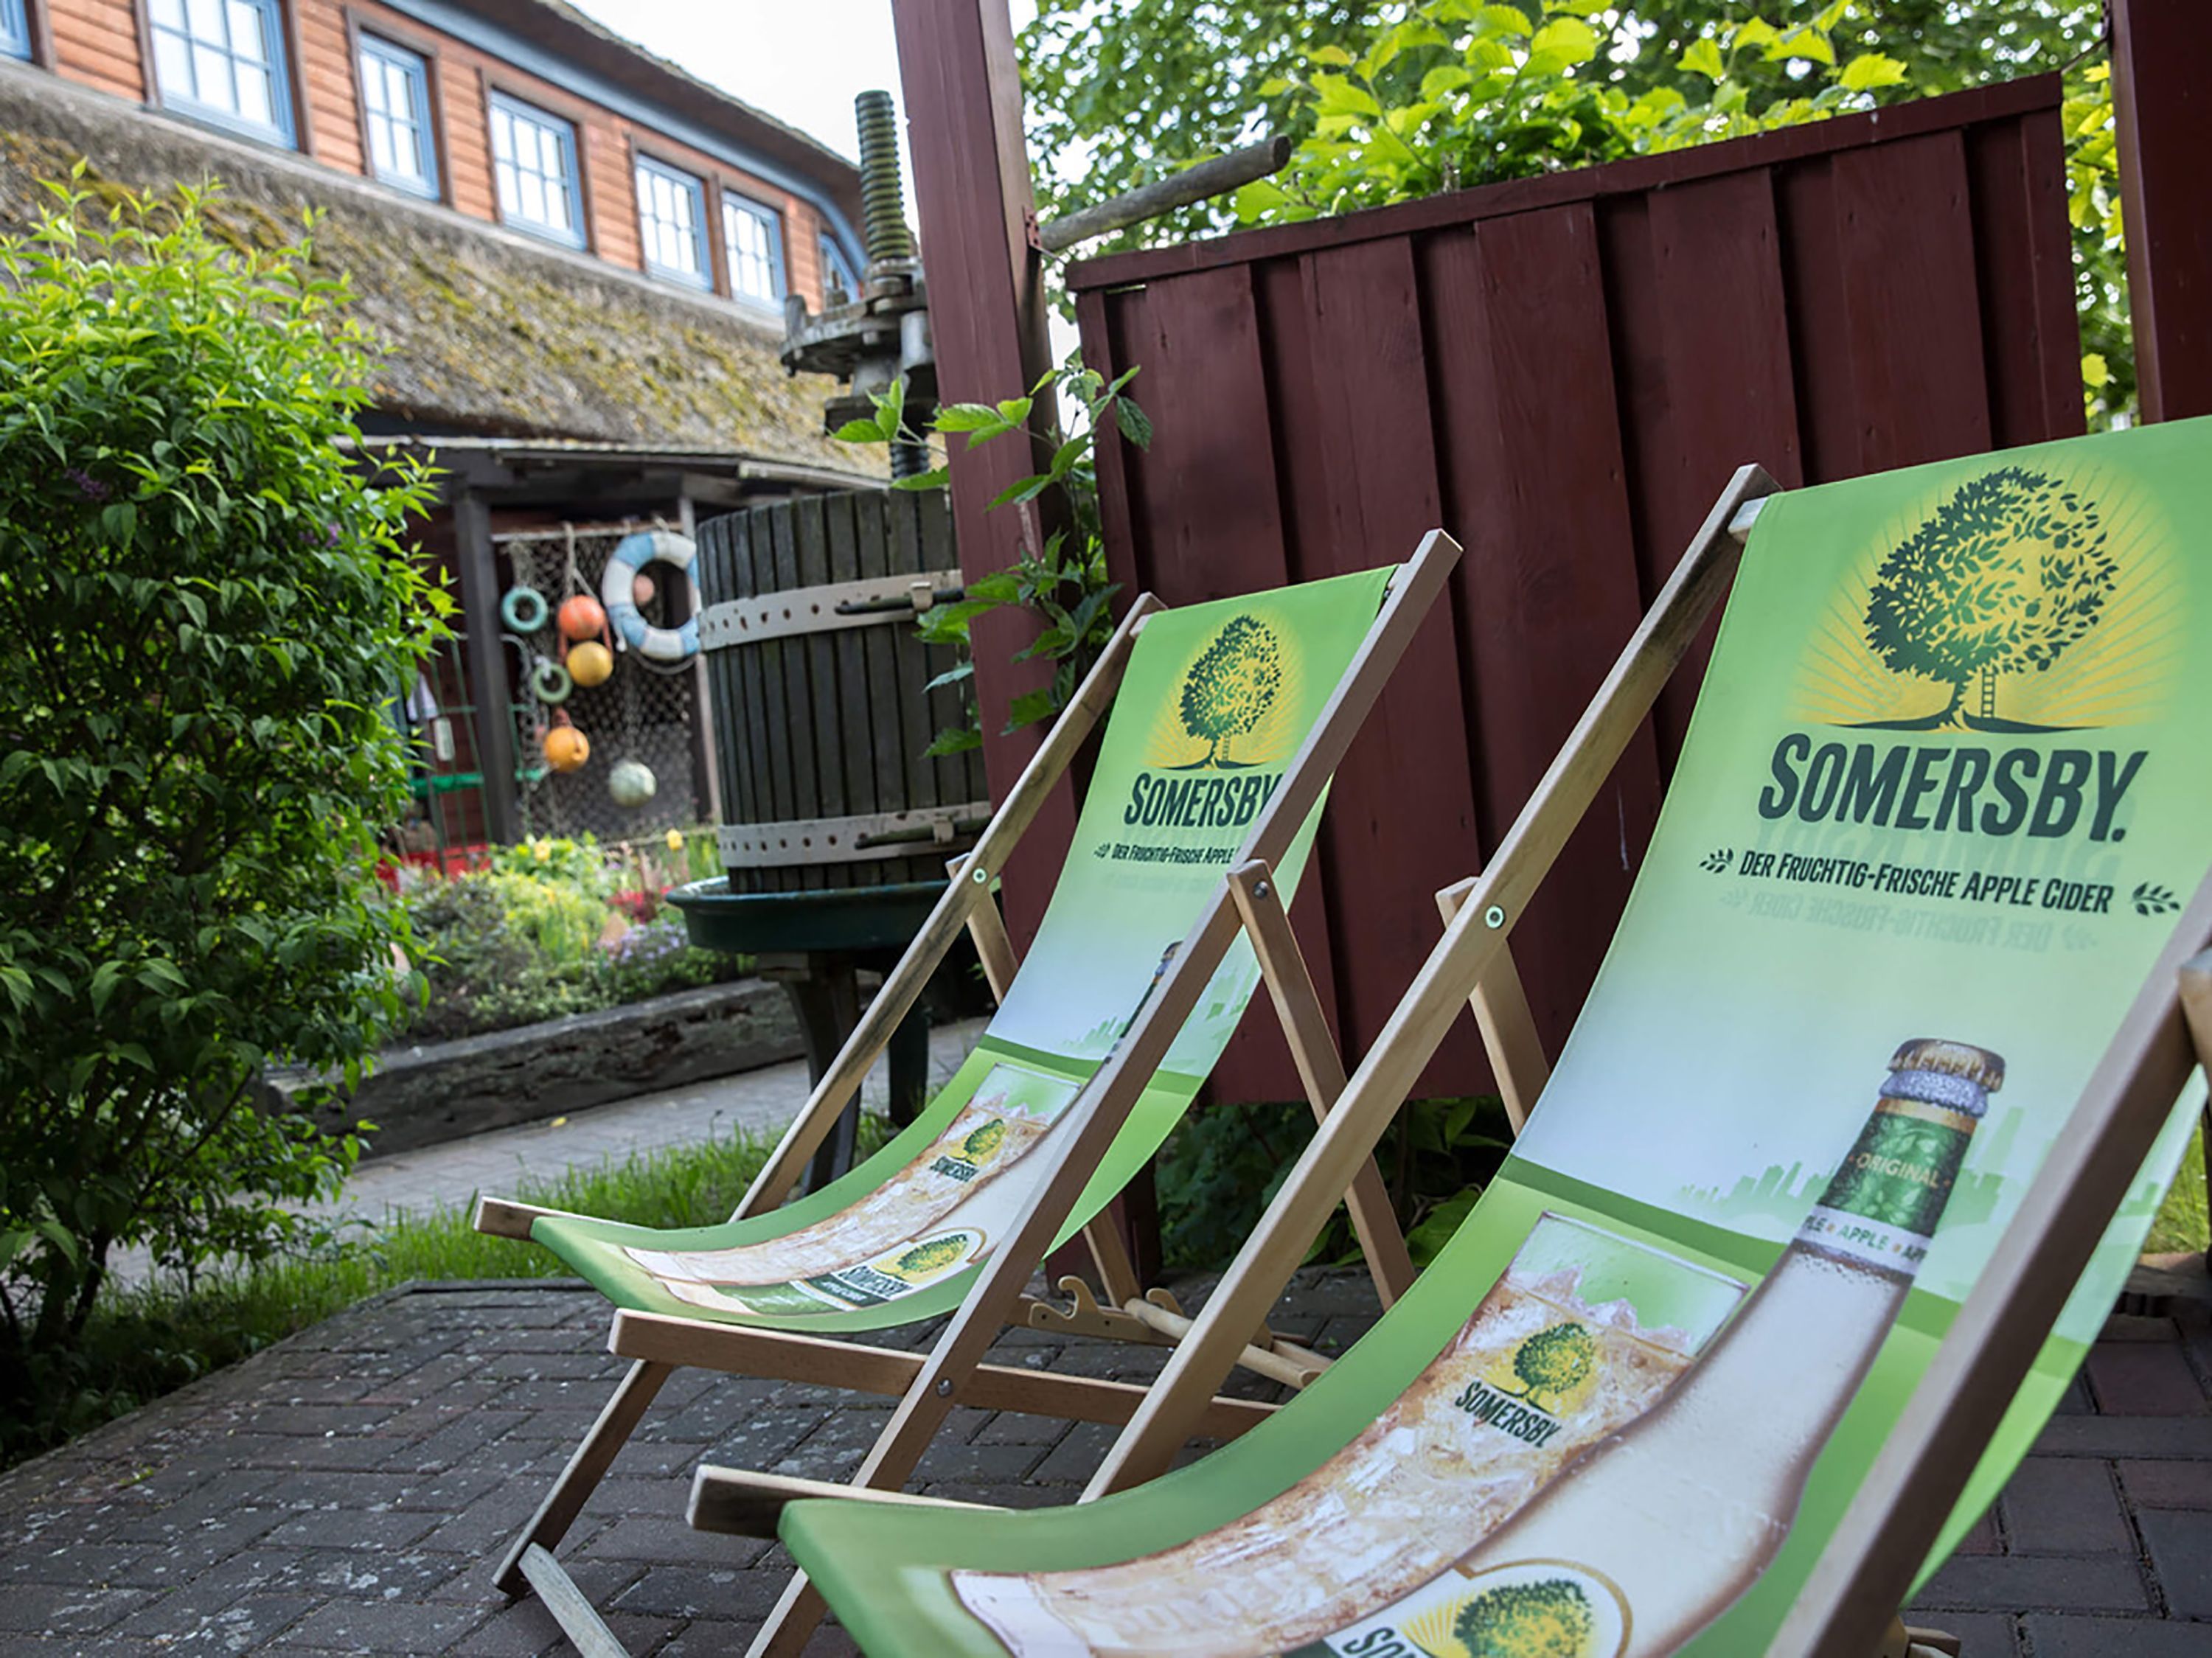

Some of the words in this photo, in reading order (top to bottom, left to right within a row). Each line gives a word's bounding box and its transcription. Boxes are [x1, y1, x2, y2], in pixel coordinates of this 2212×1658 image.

[1758, 733, 2149, 842] SOMERSBY.
[1738, 850, 1776, 877] DER
[1776, 852, 1961, 899] FRUCHTIG-FRISCHE
[1960, 871, 2040, 906] APPLE
[2040, 878, 2115, 914] CIDER
[1857, 1152, 1939, 1189] ORIGINAL
[1836, 1225, 1889, 1251] APPLE
[1454, 1380, 1563, 1449] SOMERSBY
